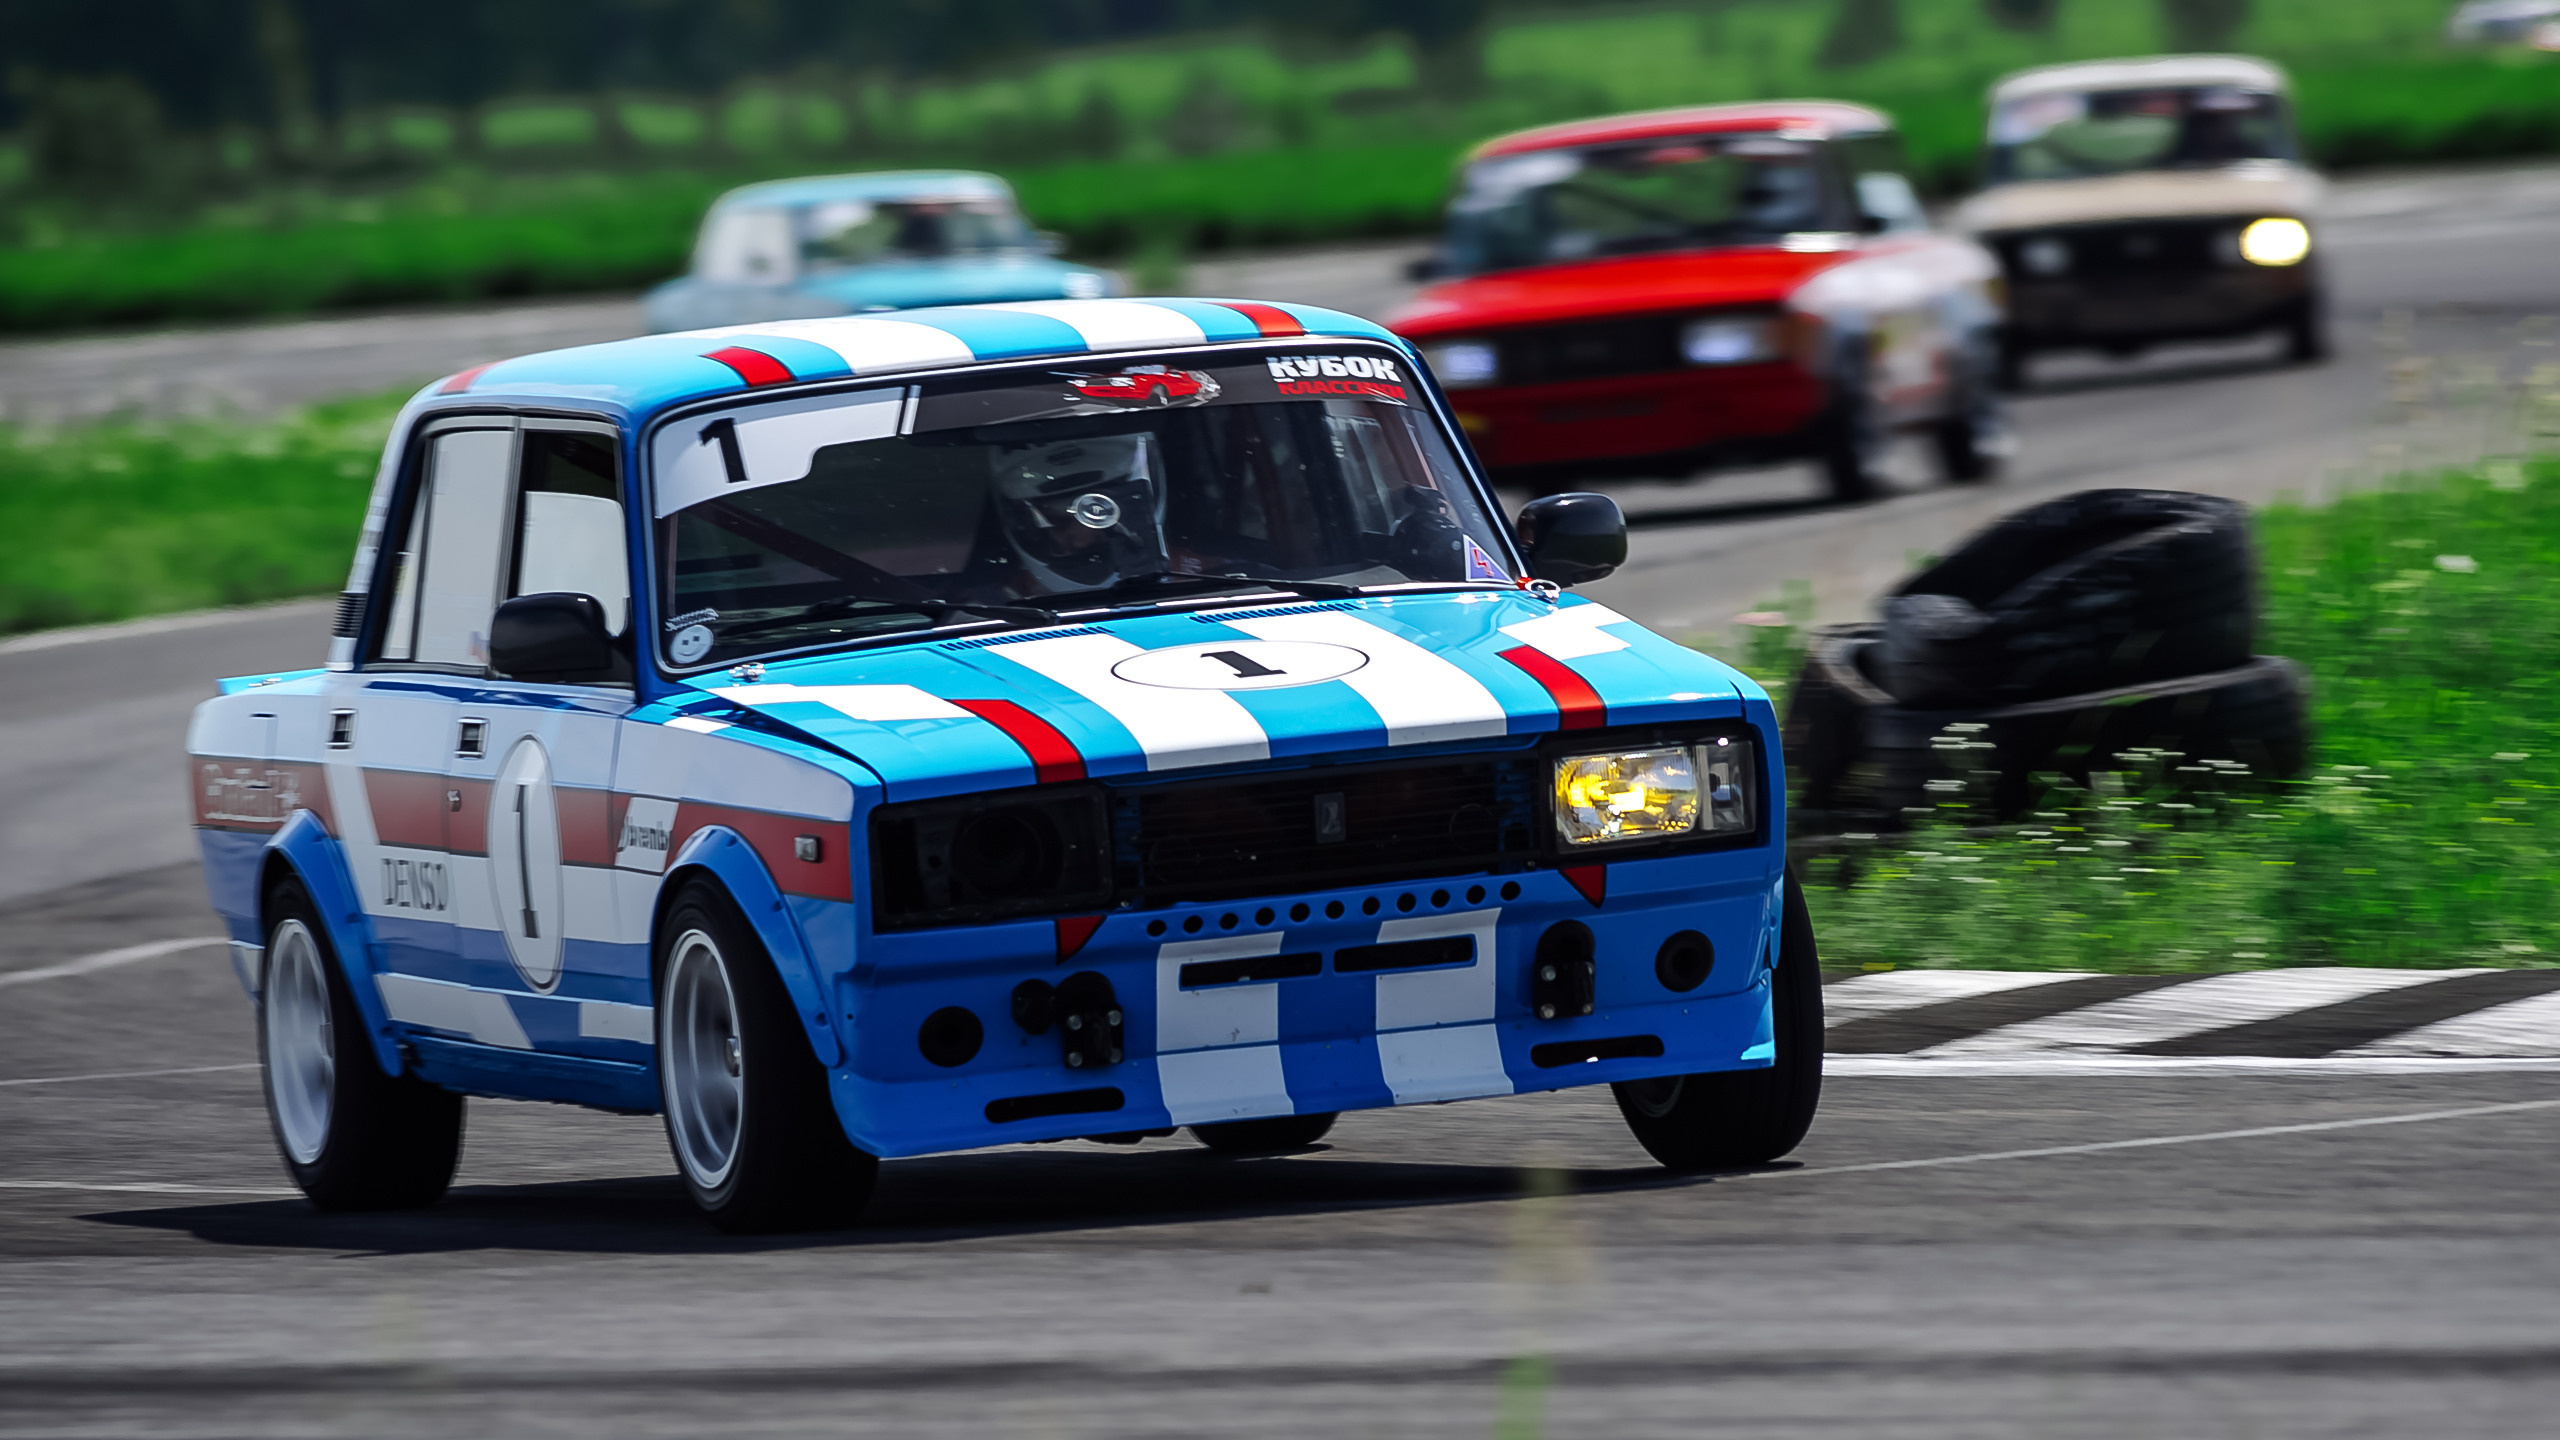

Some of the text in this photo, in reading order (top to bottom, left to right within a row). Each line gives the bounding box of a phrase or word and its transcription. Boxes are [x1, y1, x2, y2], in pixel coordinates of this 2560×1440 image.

[1265, 355, 1402, 383] КУБОК
[697, 417, 749, 484] 1
[1200, 650, 1288, 678] 1
[381, 858, 449, 911] DENSO
[513, 783, 540, 939] 1
